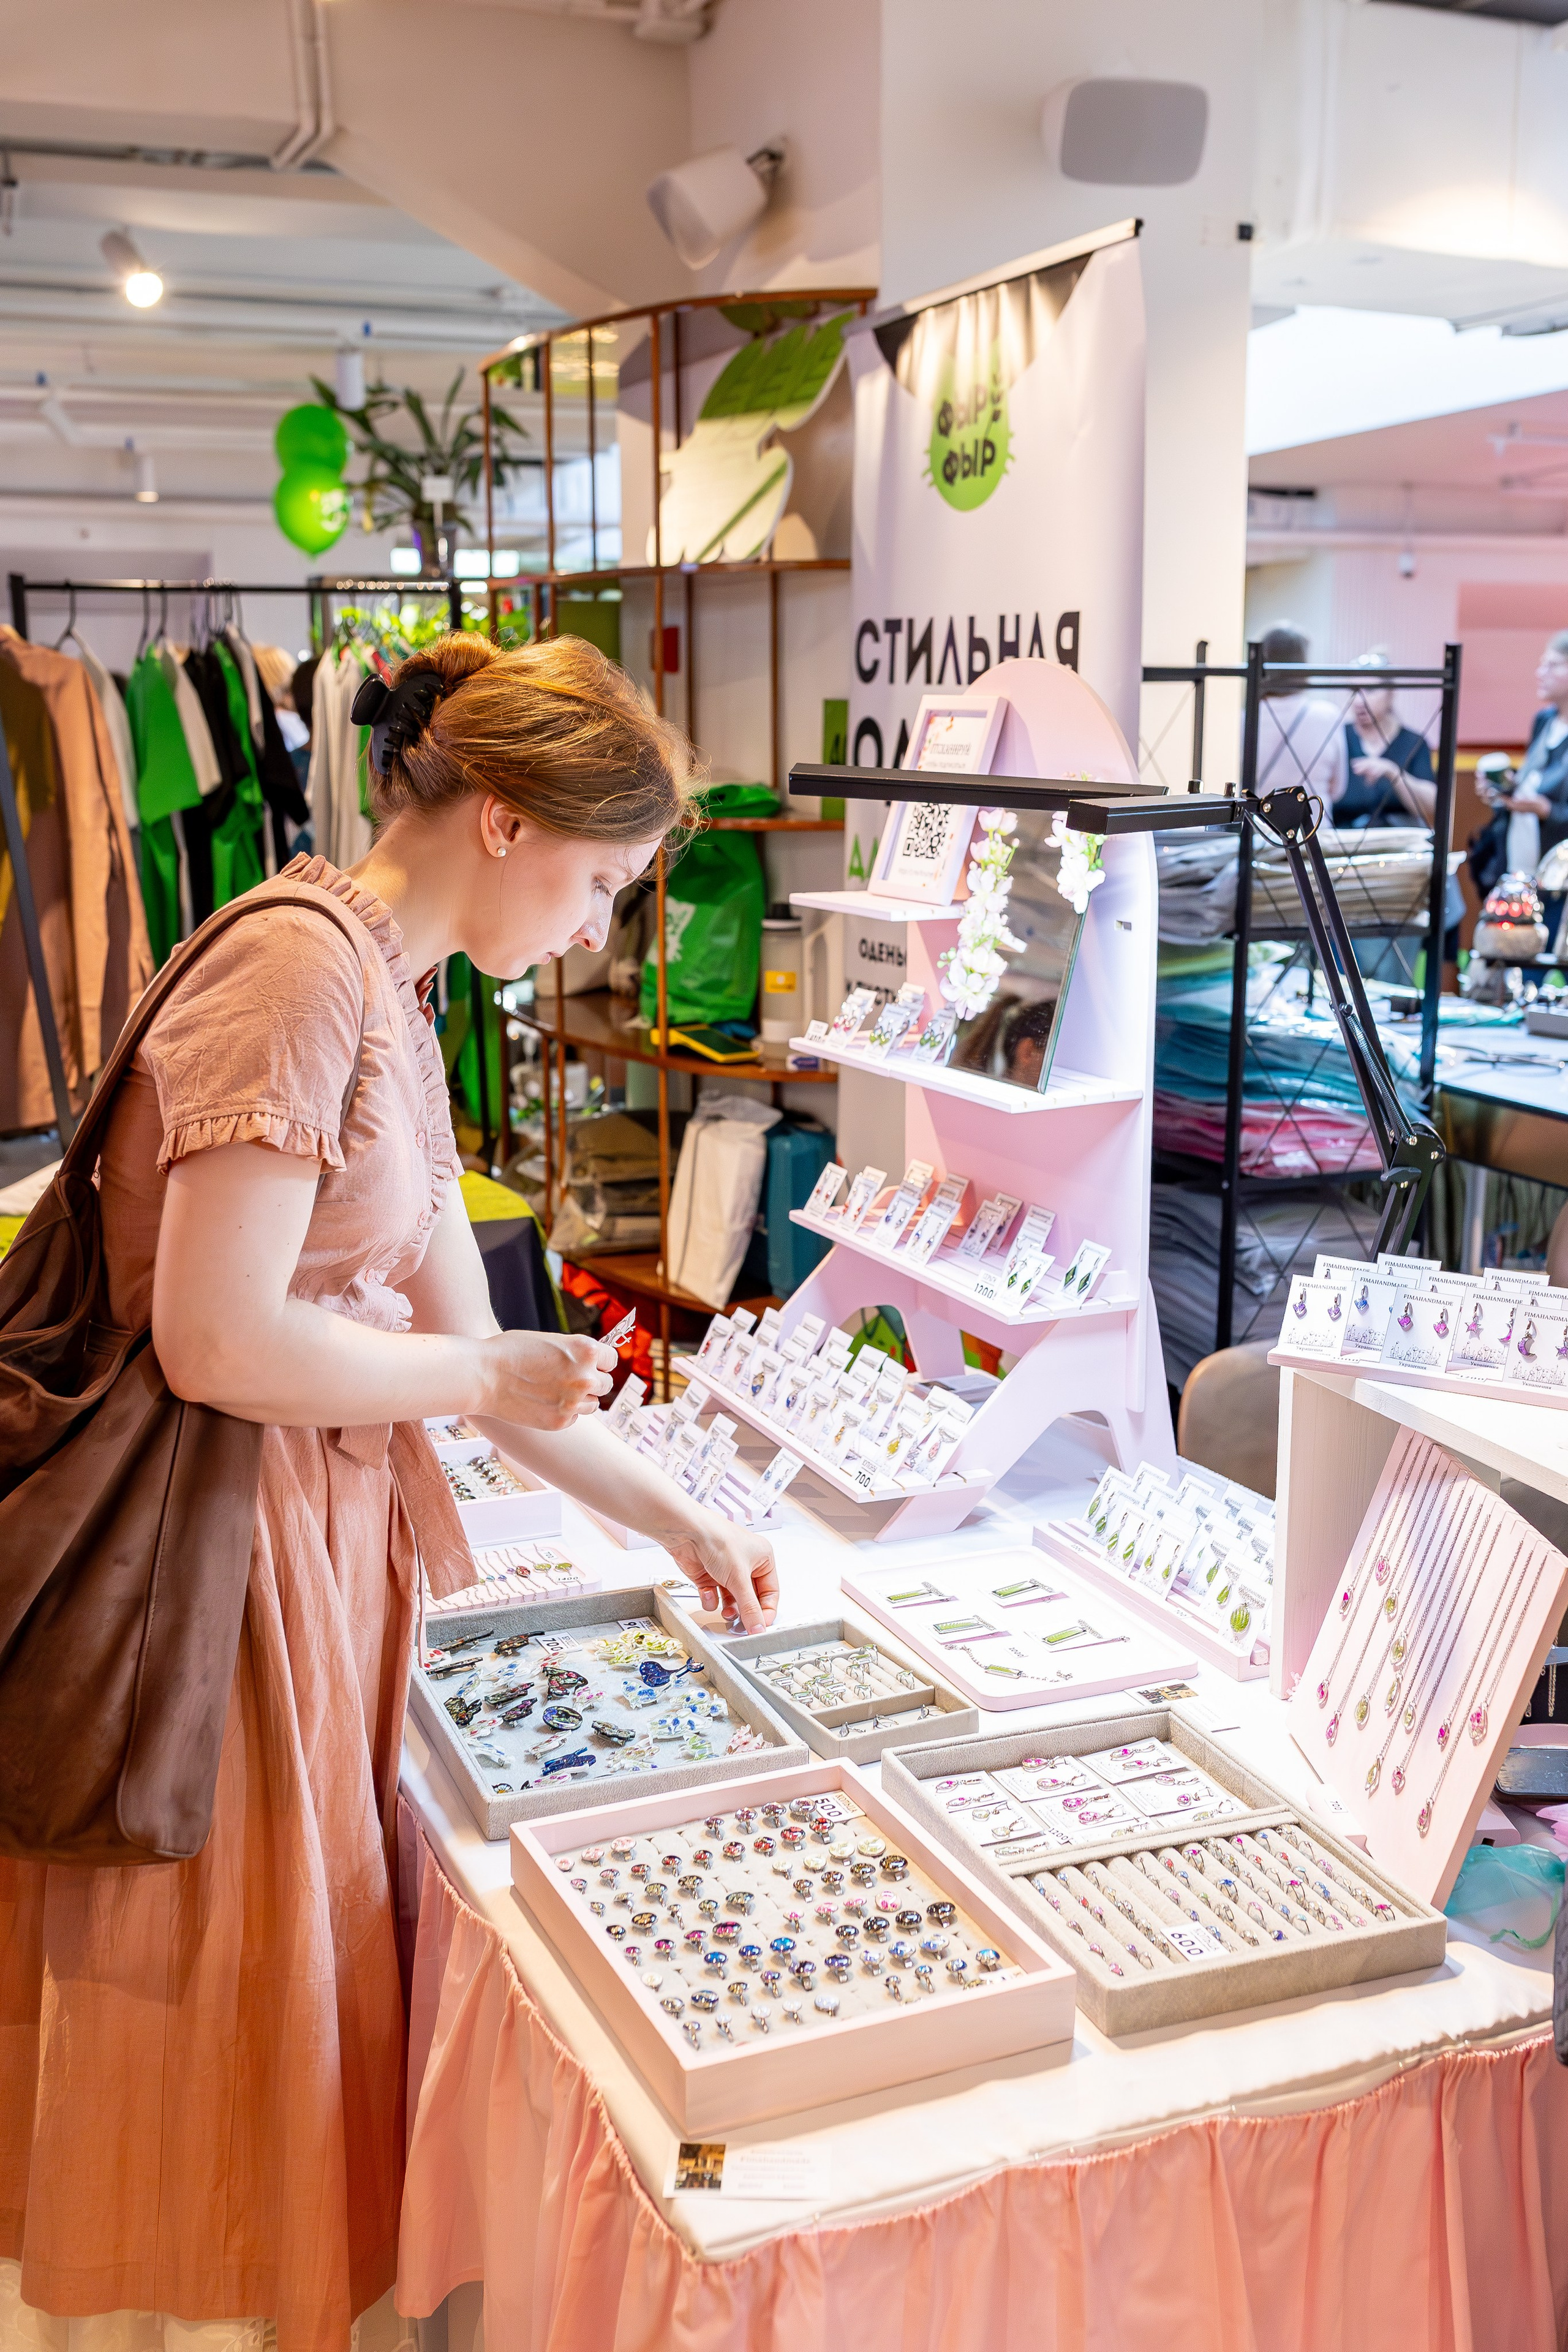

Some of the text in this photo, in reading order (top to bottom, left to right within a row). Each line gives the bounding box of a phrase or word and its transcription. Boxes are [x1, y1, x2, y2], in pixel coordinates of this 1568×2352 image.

[855, 611, 1081, 686] СТИЛЬНАЯ
[1299, 1282, 1348, 1292] FIMAHANDMADE
[1429, 1276, 1479, 1288] FIMAHANDMADE
[1403, 1294, 1453, 1307] FIMAHANDMADE
[1472, 1294, 1523, 1305] FIMAHANDMADE
[1398, 1361, 1427, 1371] Украшения
[855, 1471, 870, 1488] 700
[542, 1638, 564, 1651] 700
[815, 1798, 843, 1817] 500
[1048, 1828, 1069, 1841] 1200
[1170, 1932, 1204, 1956] 600
